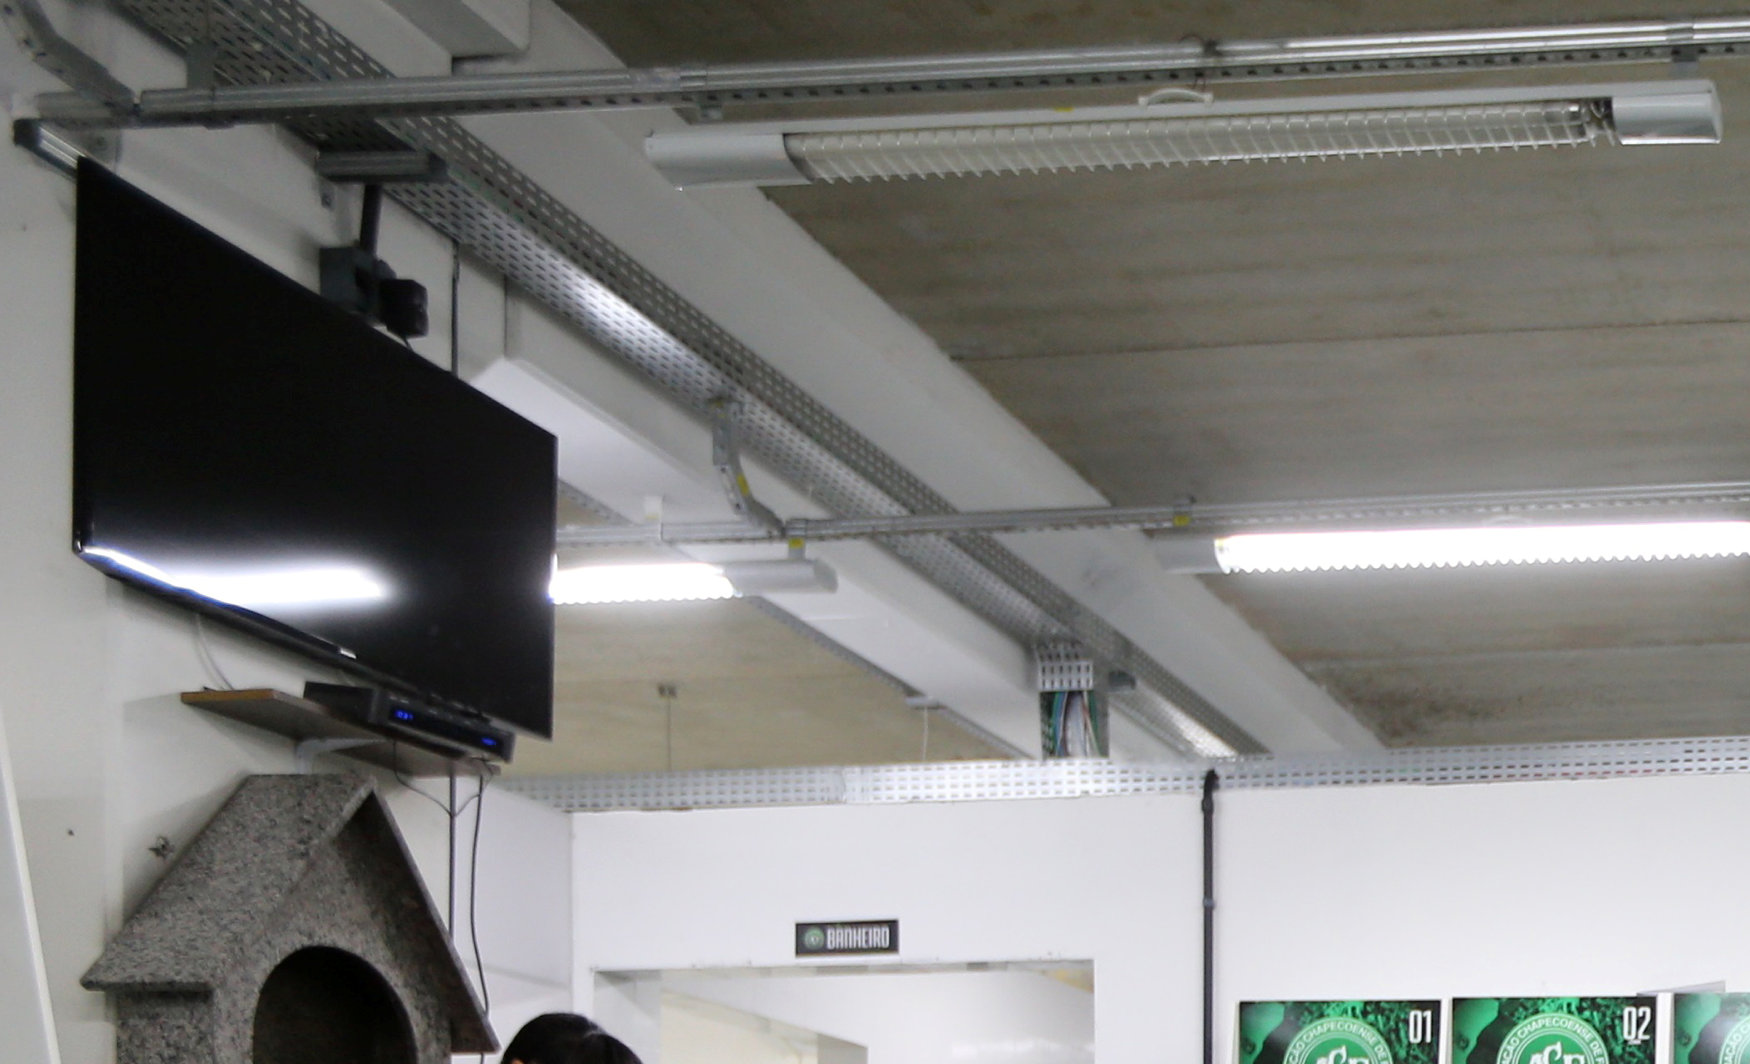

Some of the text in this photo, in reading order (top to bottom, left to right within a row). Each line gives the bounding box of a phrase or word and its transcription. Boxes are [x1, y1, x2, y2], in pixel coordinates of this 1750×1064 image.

[826, 926, 890, 950] BANHEIRO
[1409, 1010, 1432, 1043] 01
[1517, 1017, 1593, 1041] CHAPECOENSE
[1623, 1007, 1651, 1041] 02
